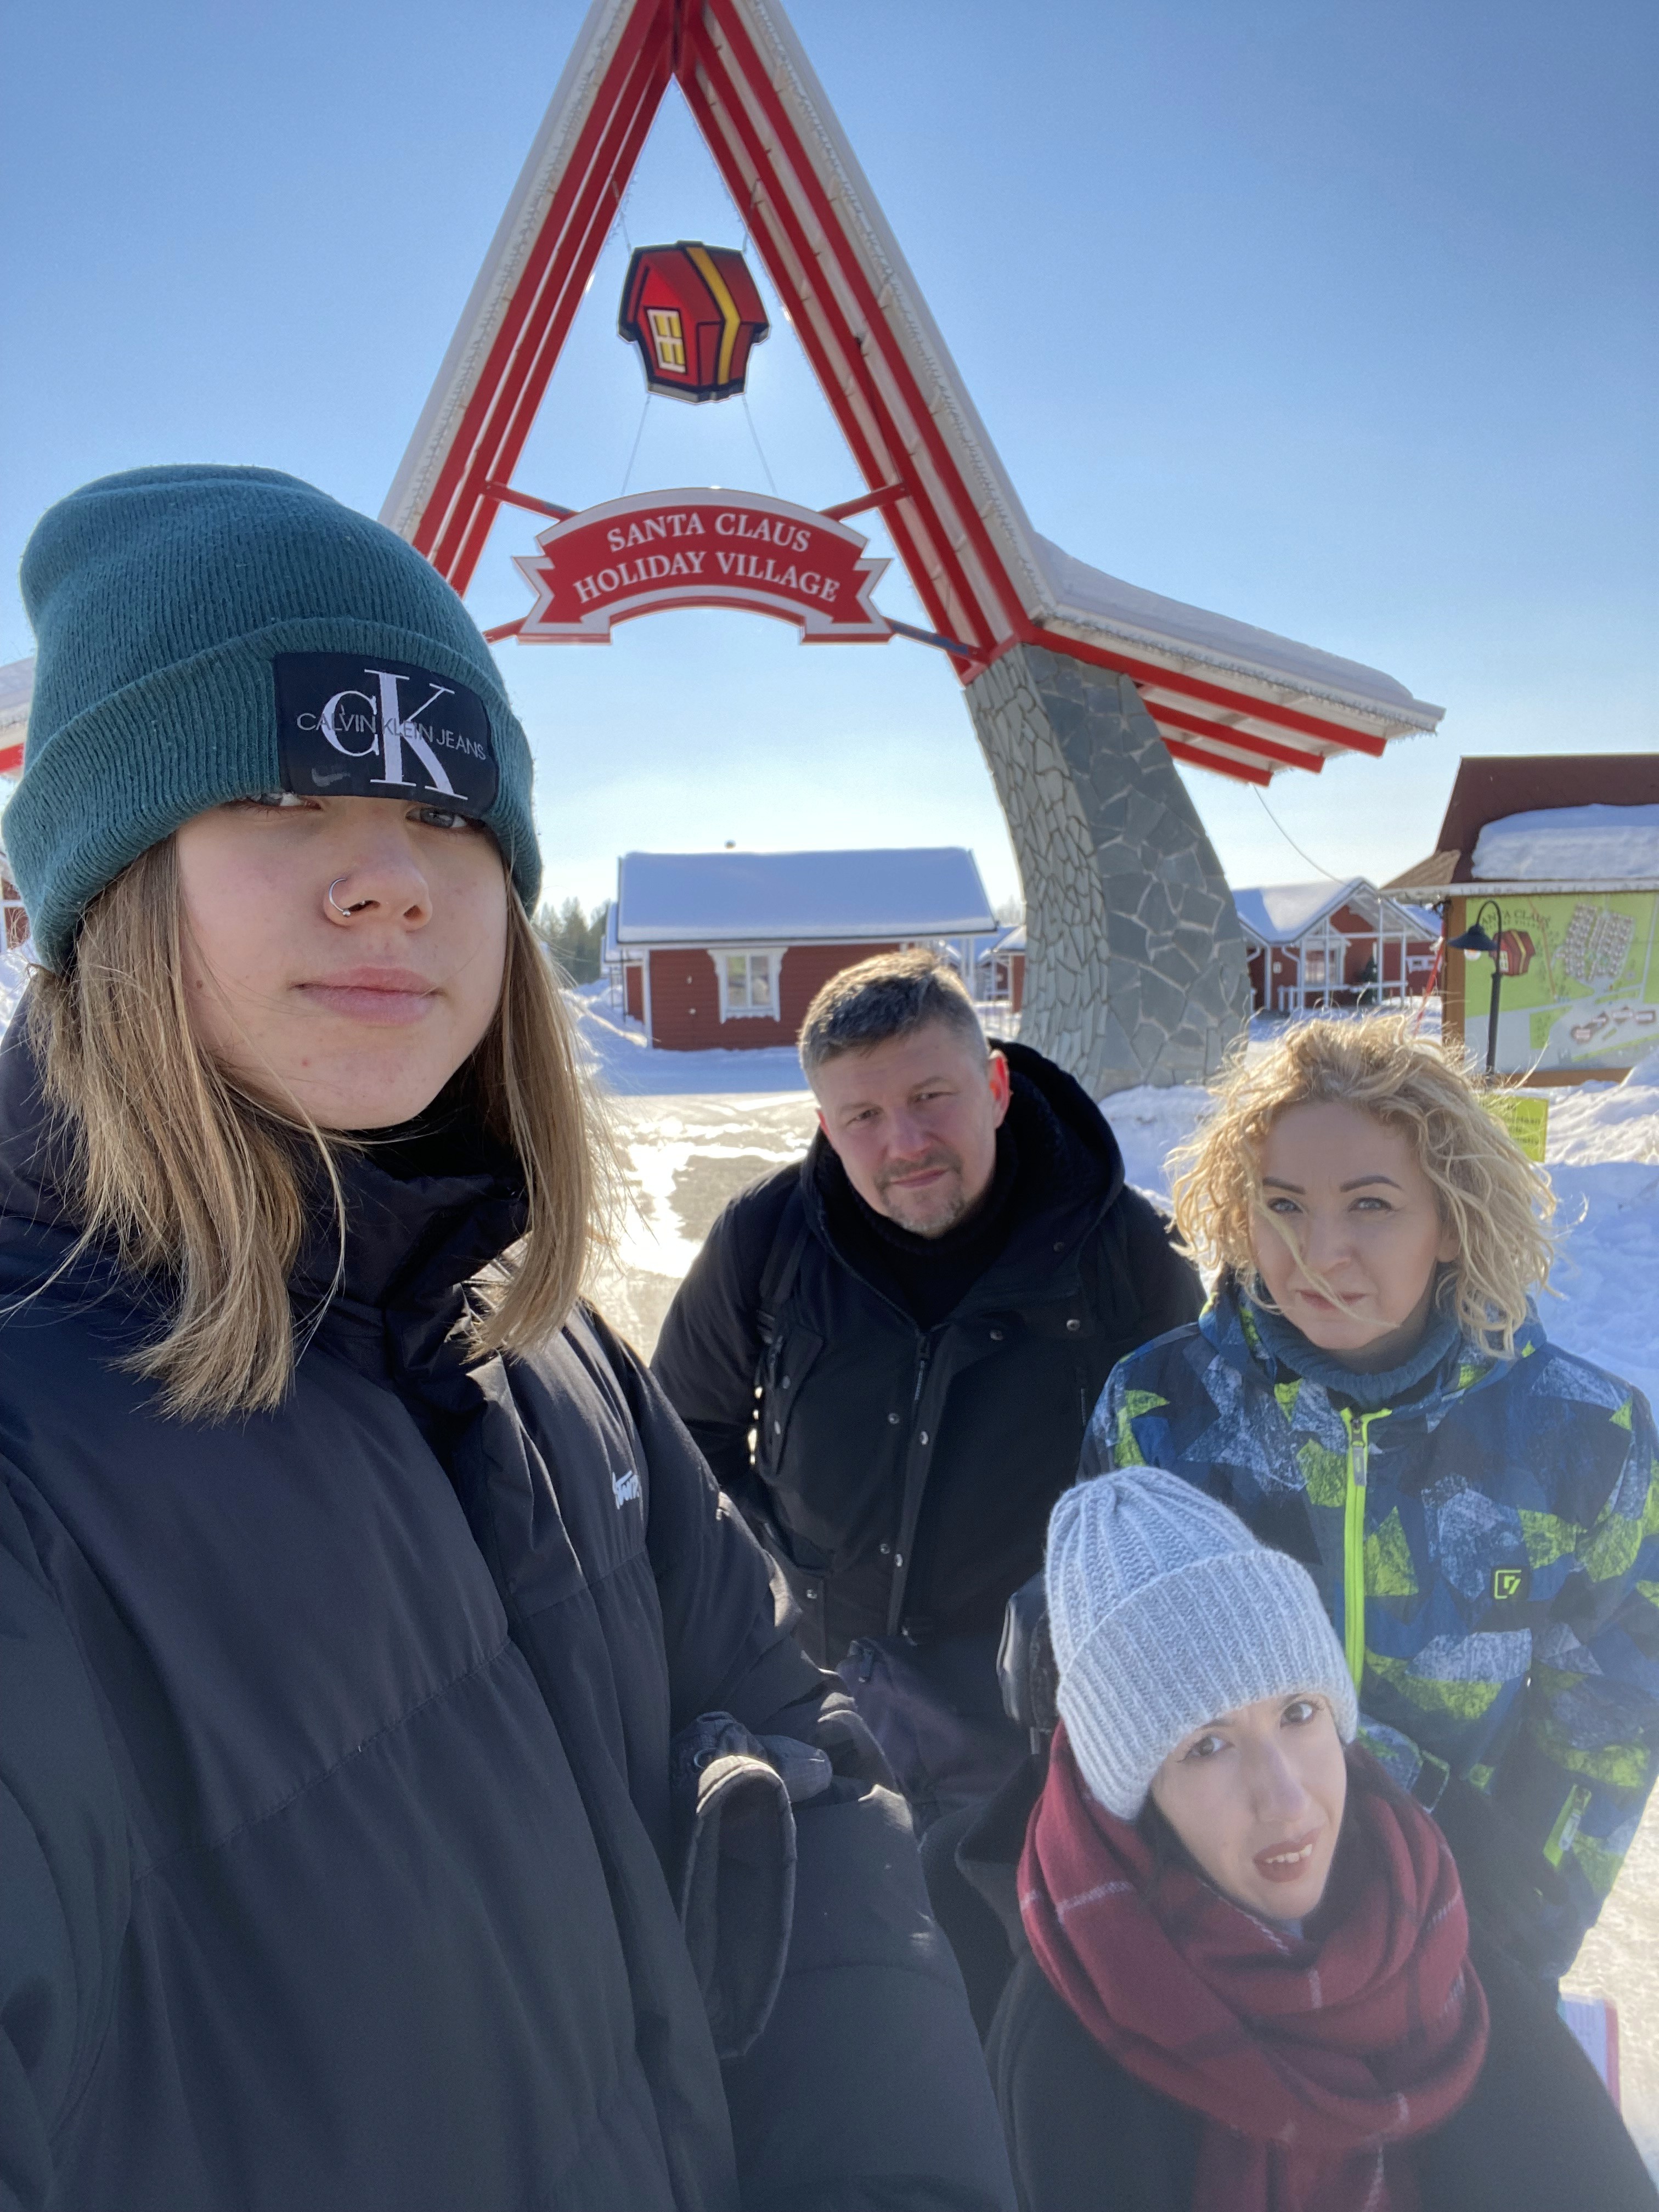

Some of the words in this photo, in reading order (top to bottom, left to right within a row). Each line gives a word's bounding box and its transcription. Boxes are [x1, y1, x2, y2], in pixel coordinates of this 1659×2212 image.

[607, 512, 706, 552] SANTA
[714, 512, 812, 552] CLAUS
[572, 550, 707, 603] HOLIDAY
[714, 550, 840, 602] VILLAGE
[296, 712, 377, 735] CALVIN
[382, 717, 433, 743] KLEIN
[436, 728, 487, 761] JEANS
